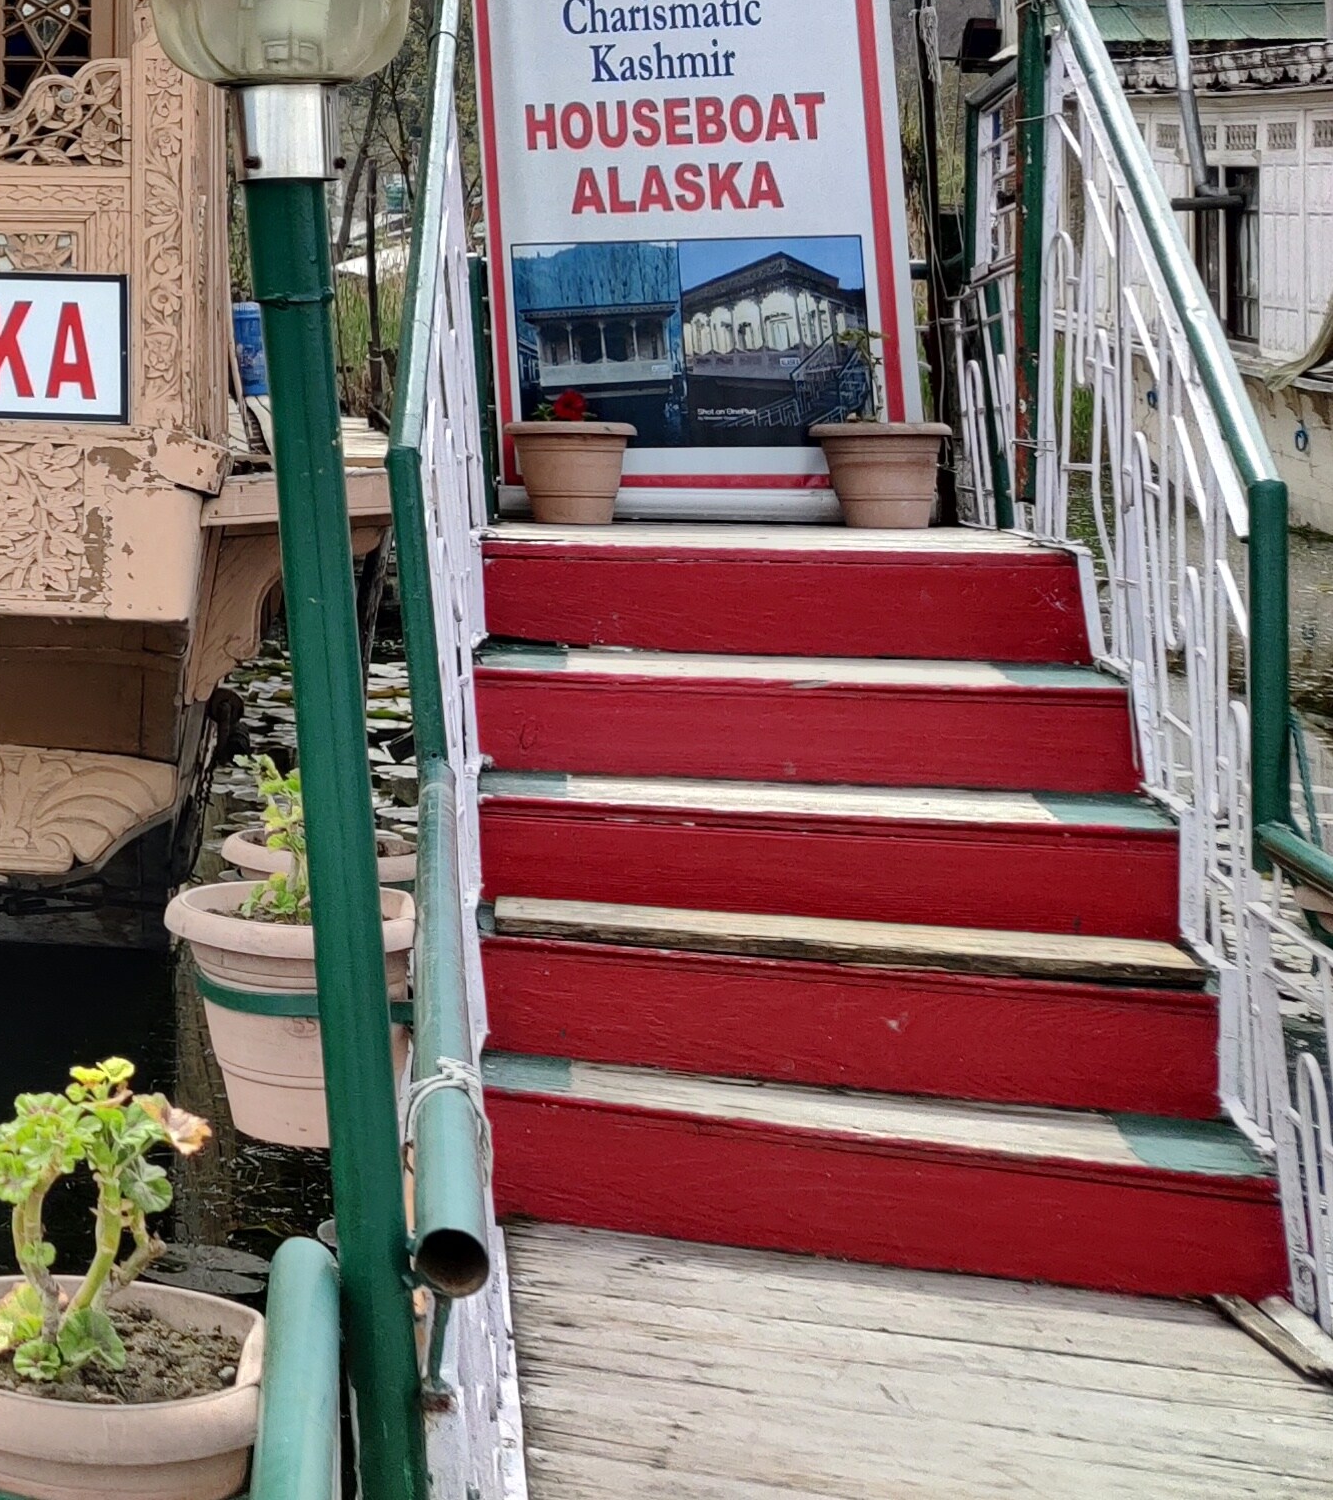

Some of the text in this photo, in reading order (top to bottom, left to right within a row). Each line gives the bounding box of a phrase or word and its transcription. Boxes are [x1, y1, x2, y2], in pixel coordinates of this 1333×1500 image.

[589, 38, 736, 82] Kashmir
[524, 91, 826, 151] HOUSEBOAT
[571, 160, 785, 215] ALASKA
